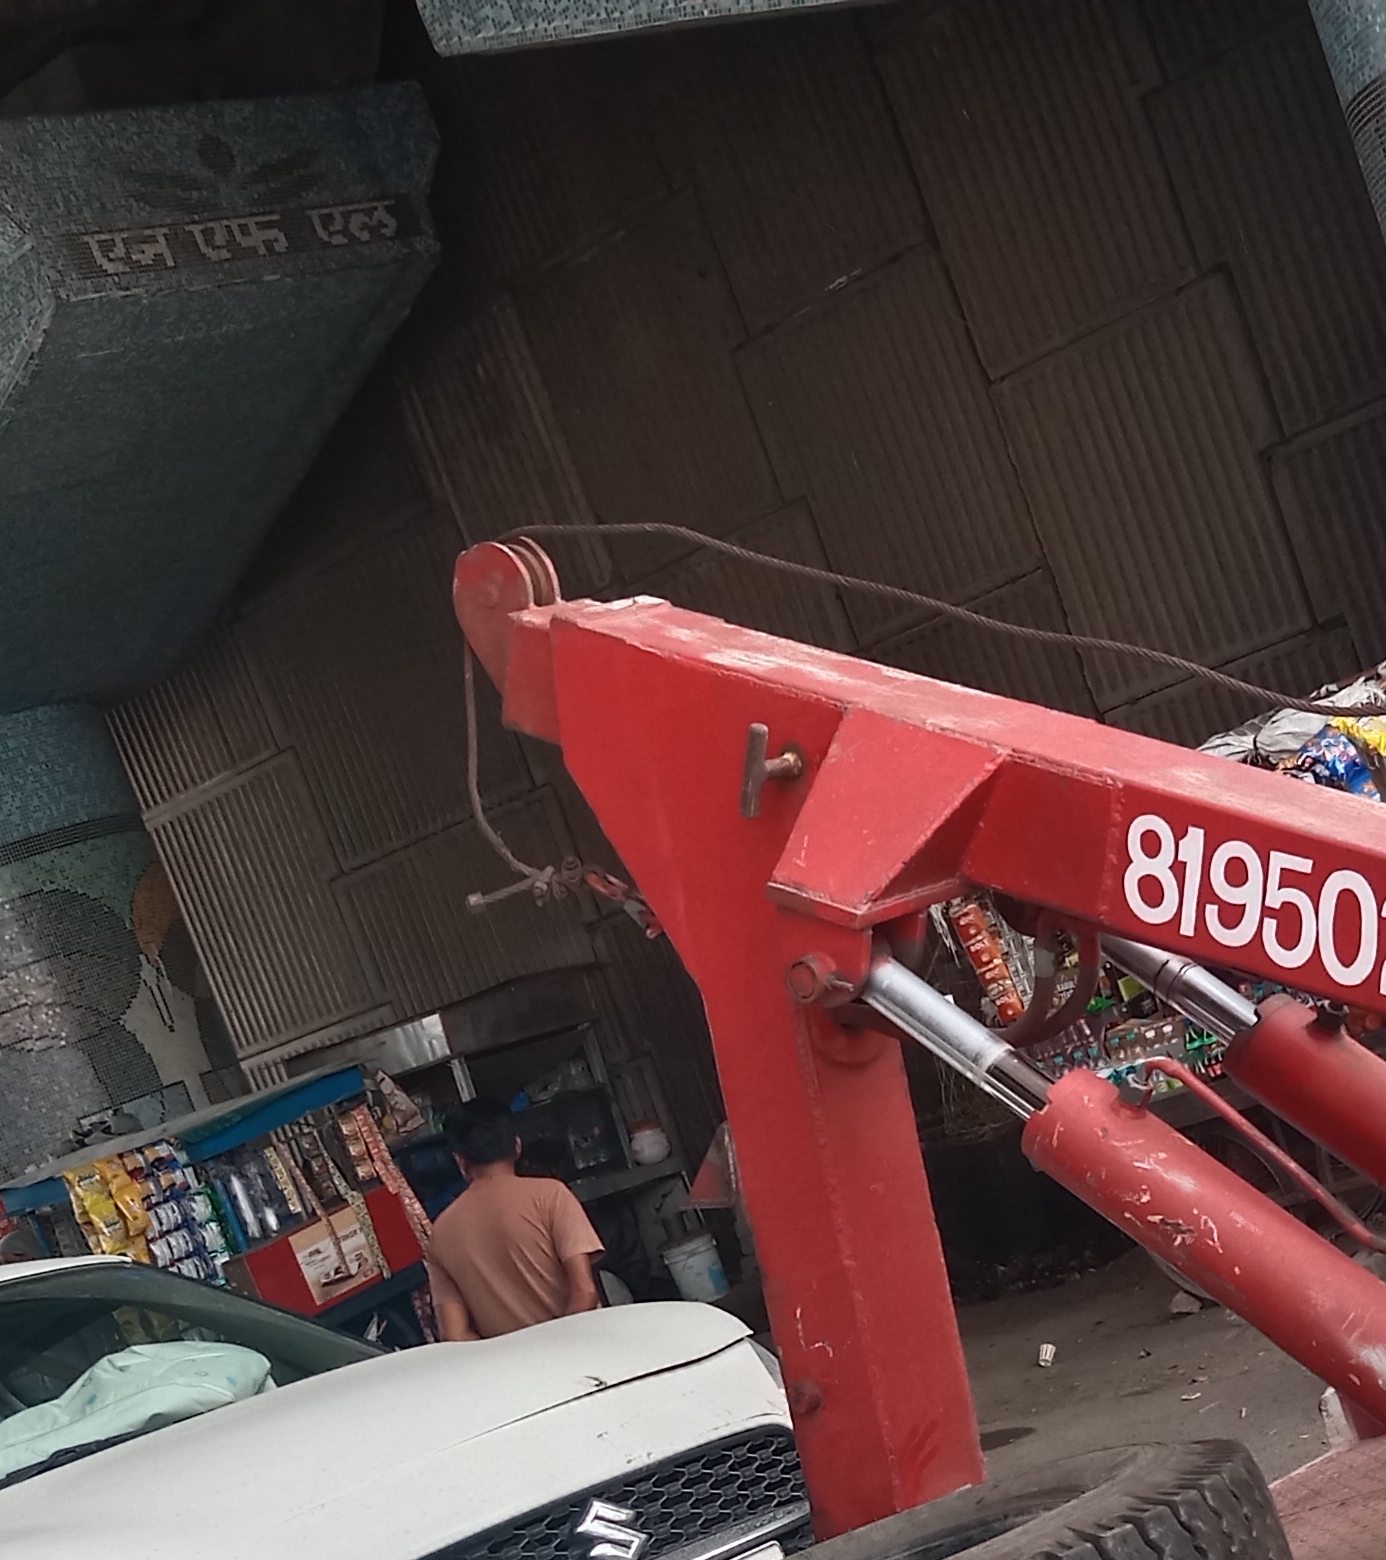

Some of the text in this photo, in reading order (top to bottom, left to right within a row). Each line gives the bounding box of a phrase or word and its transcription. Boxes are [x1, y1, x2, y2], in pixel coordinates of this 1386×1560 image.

[84, 200, 398, 274] एन एफ एल
